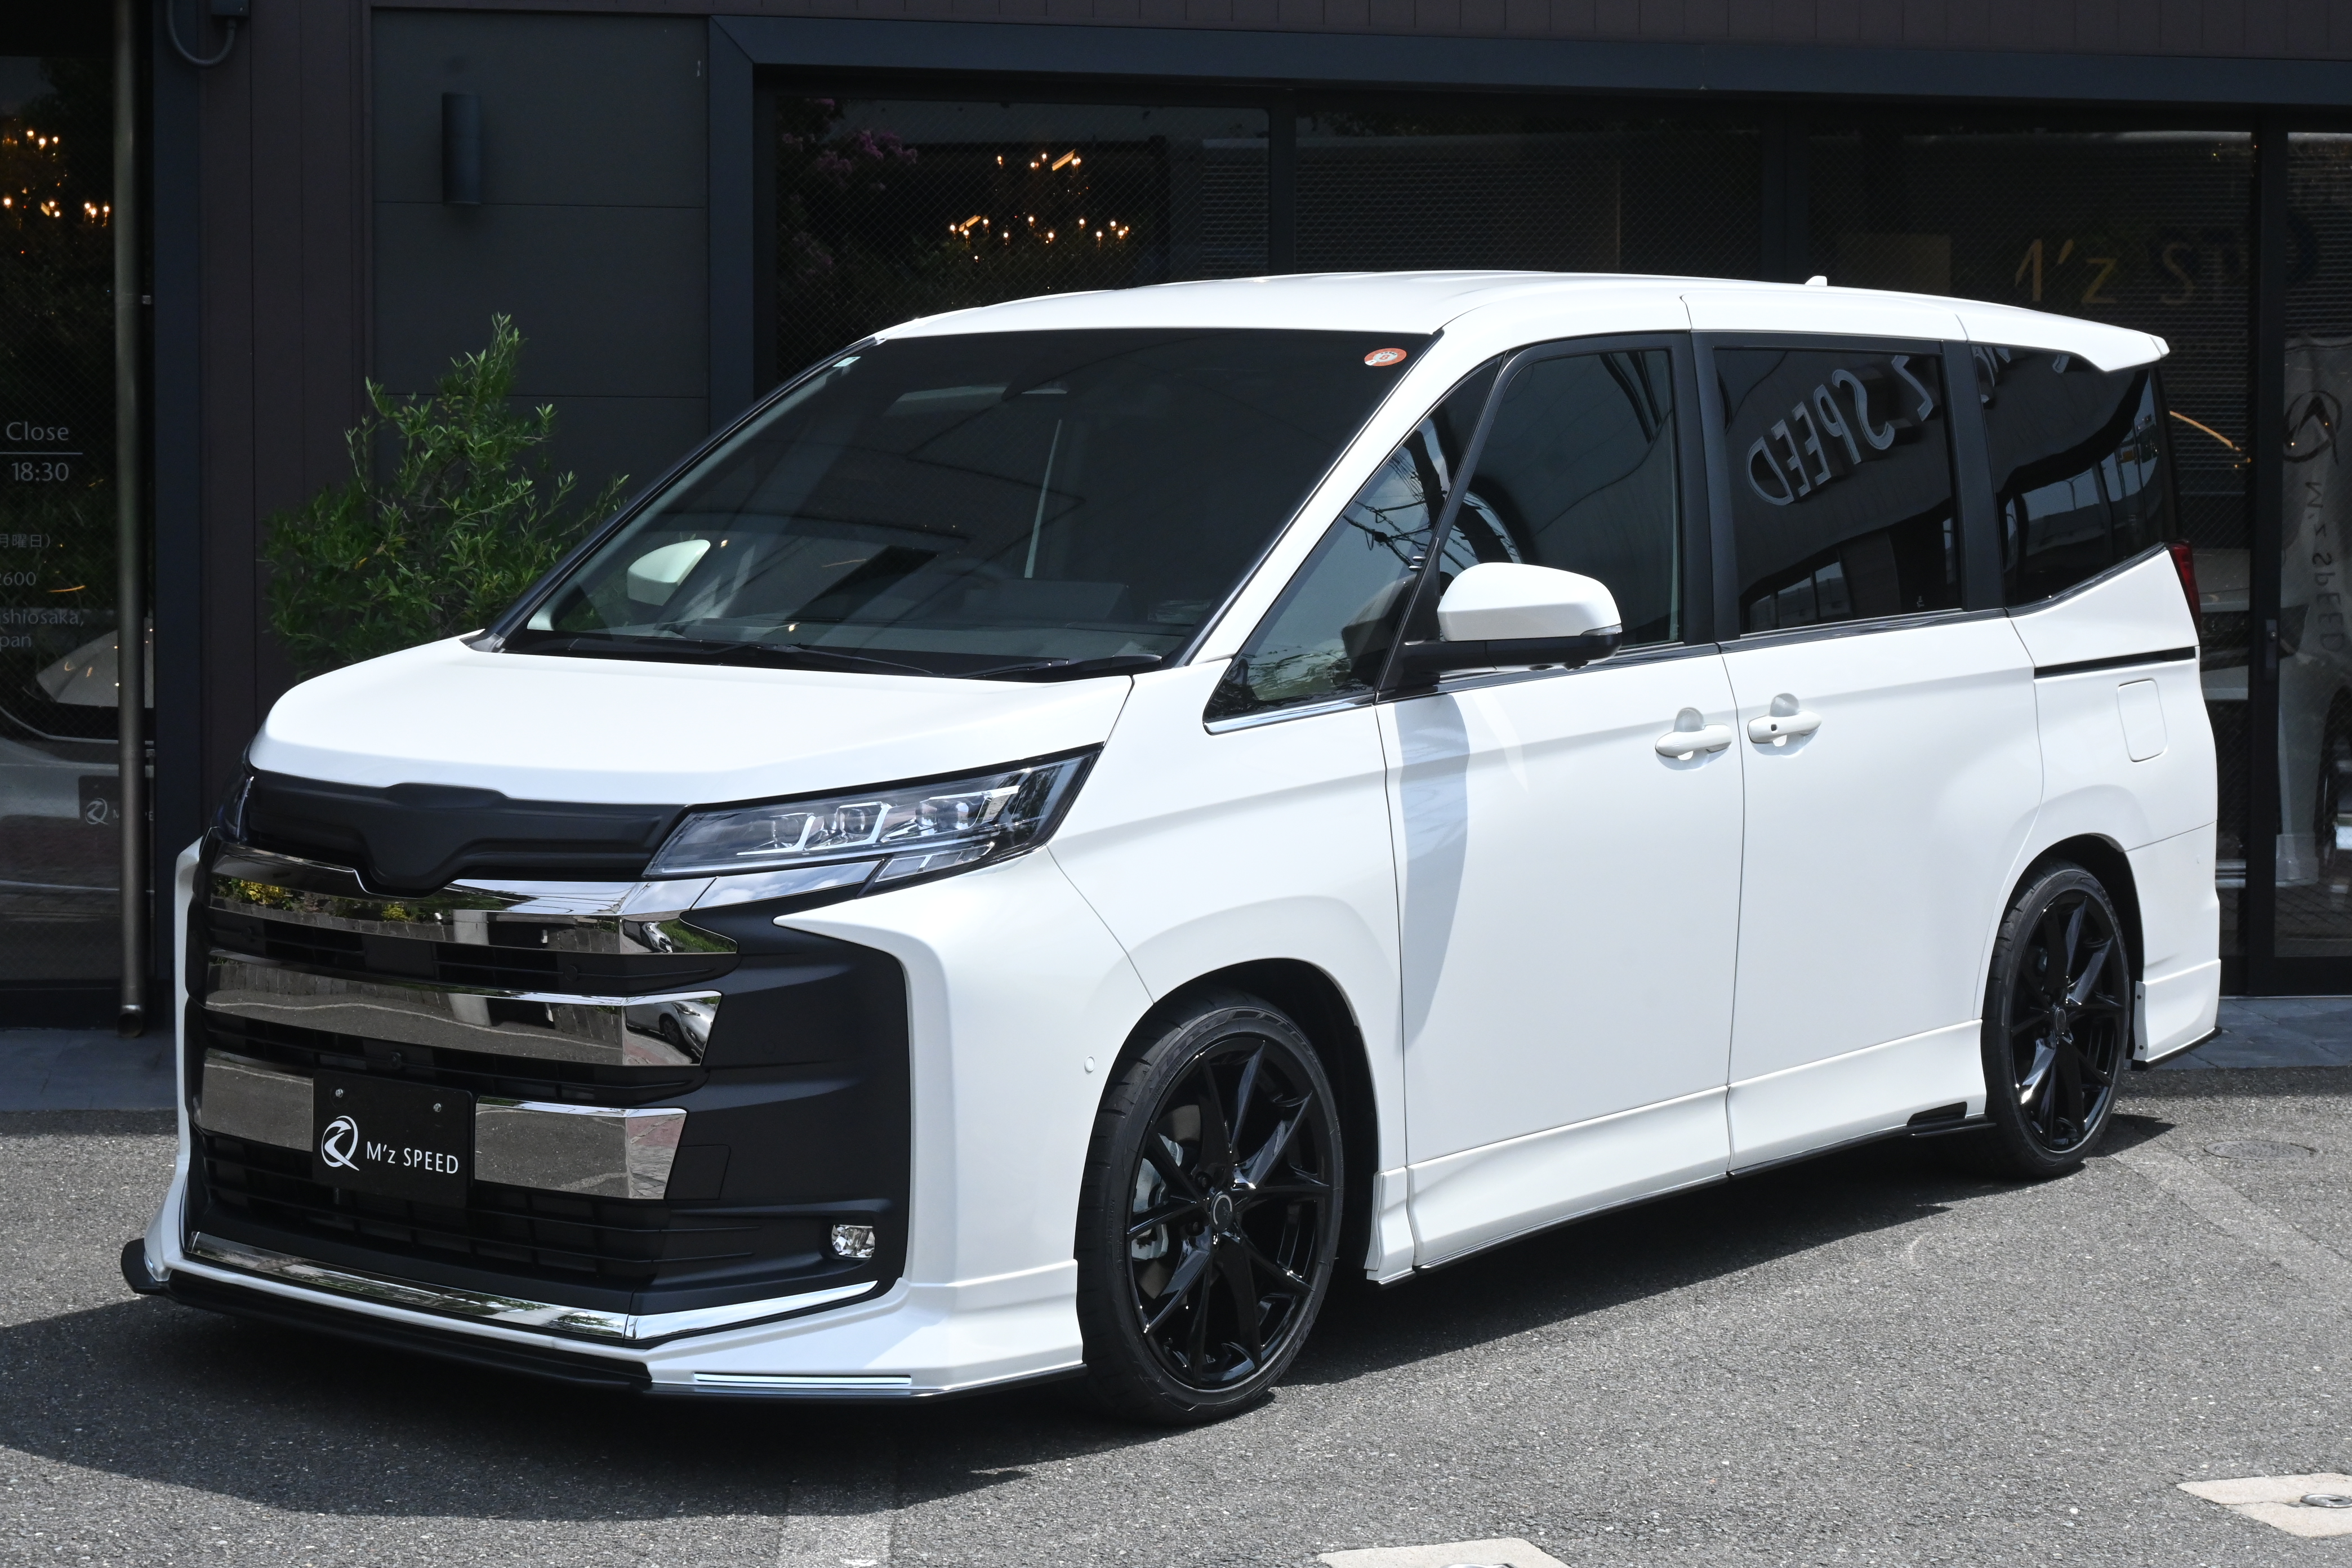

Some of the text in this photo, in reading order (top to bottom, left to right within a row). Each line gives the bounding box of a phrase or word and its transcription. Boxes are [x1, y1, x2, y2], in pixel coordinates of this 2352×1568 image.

[6, 421, 69, 442] Close
[11, 462, 69, 482] 18:30
[0, 608, 84, 627] shiosaka,
[367, 1141, 459, 1174] M'z SPEED
